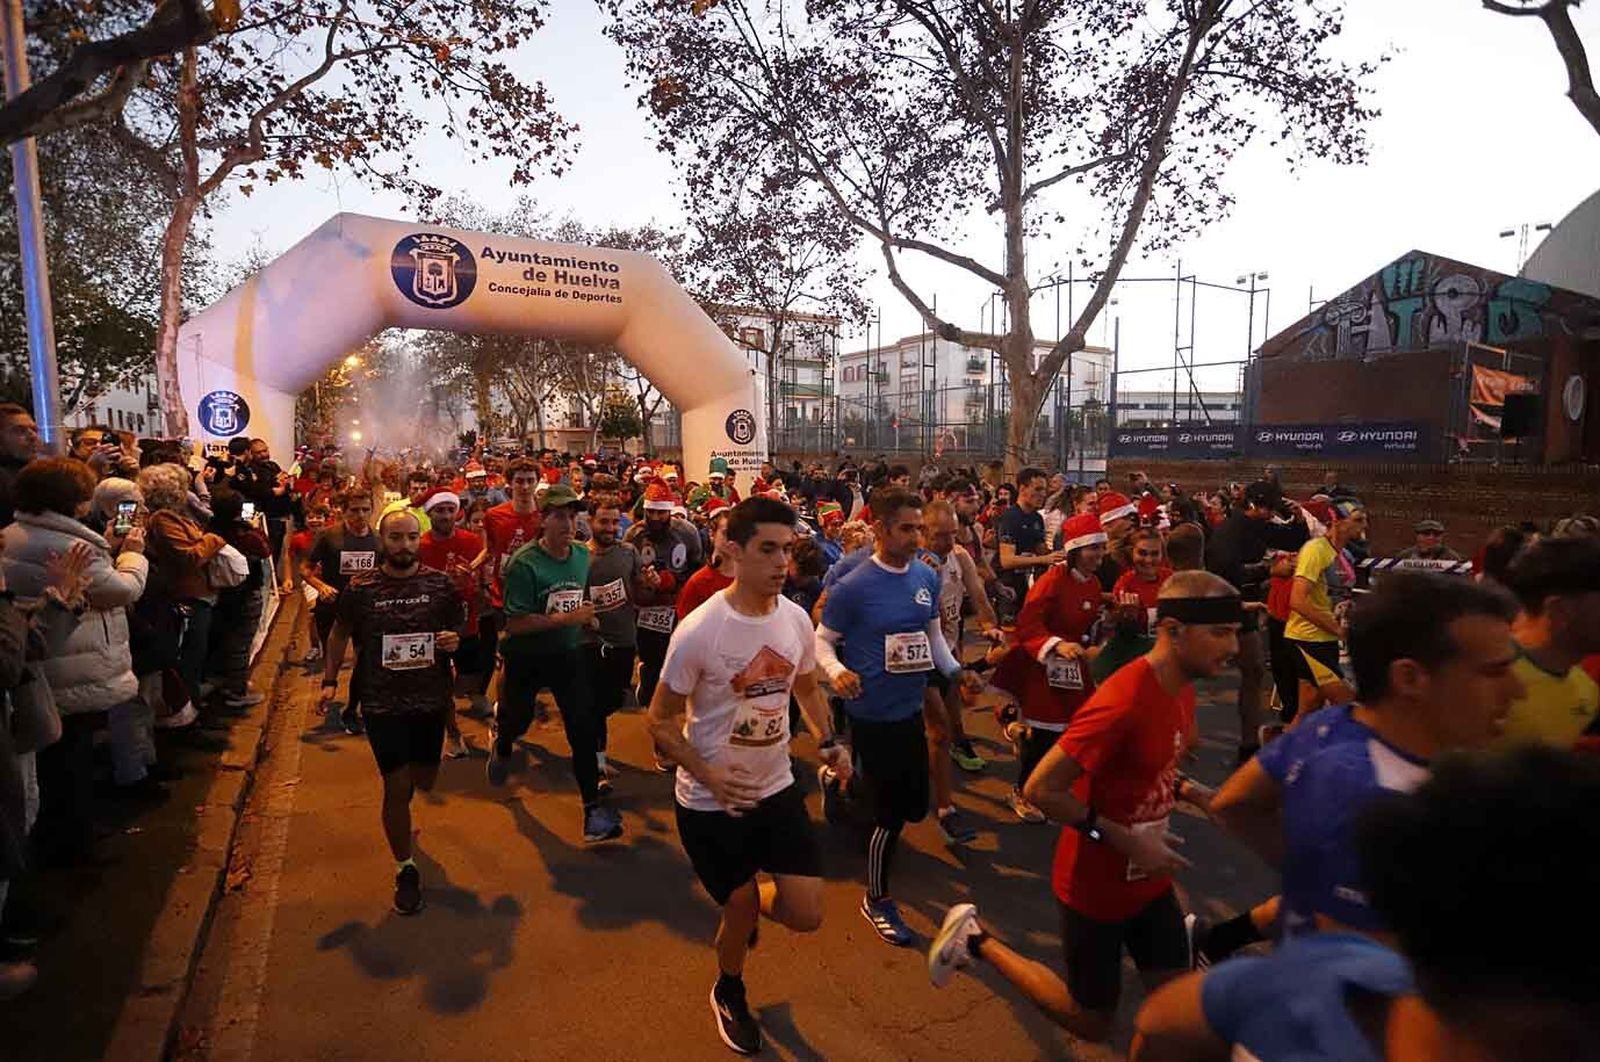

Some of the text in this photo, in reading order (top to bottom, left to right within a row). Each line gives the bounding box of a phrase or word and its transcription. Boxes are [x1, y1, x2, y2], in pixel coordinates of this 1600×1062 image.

[480, 246, 620, 273] Ayuntamiento
[523, 267, 621, 290] de Huelva
[555, 288, 569, 299] de
[572, 290, 622, 304] Deportes
[1133, 434, 1169, 442] HYUNDAI
[1194, 433, 1234, 442] HYUNDAI
[1275, 432, 1324, 441] HYUNDAI
[1360, 431, 1418, 441] HYUNDAI
[409, 644, 426, 659] 54
[907, 644, 928, 660] 572
